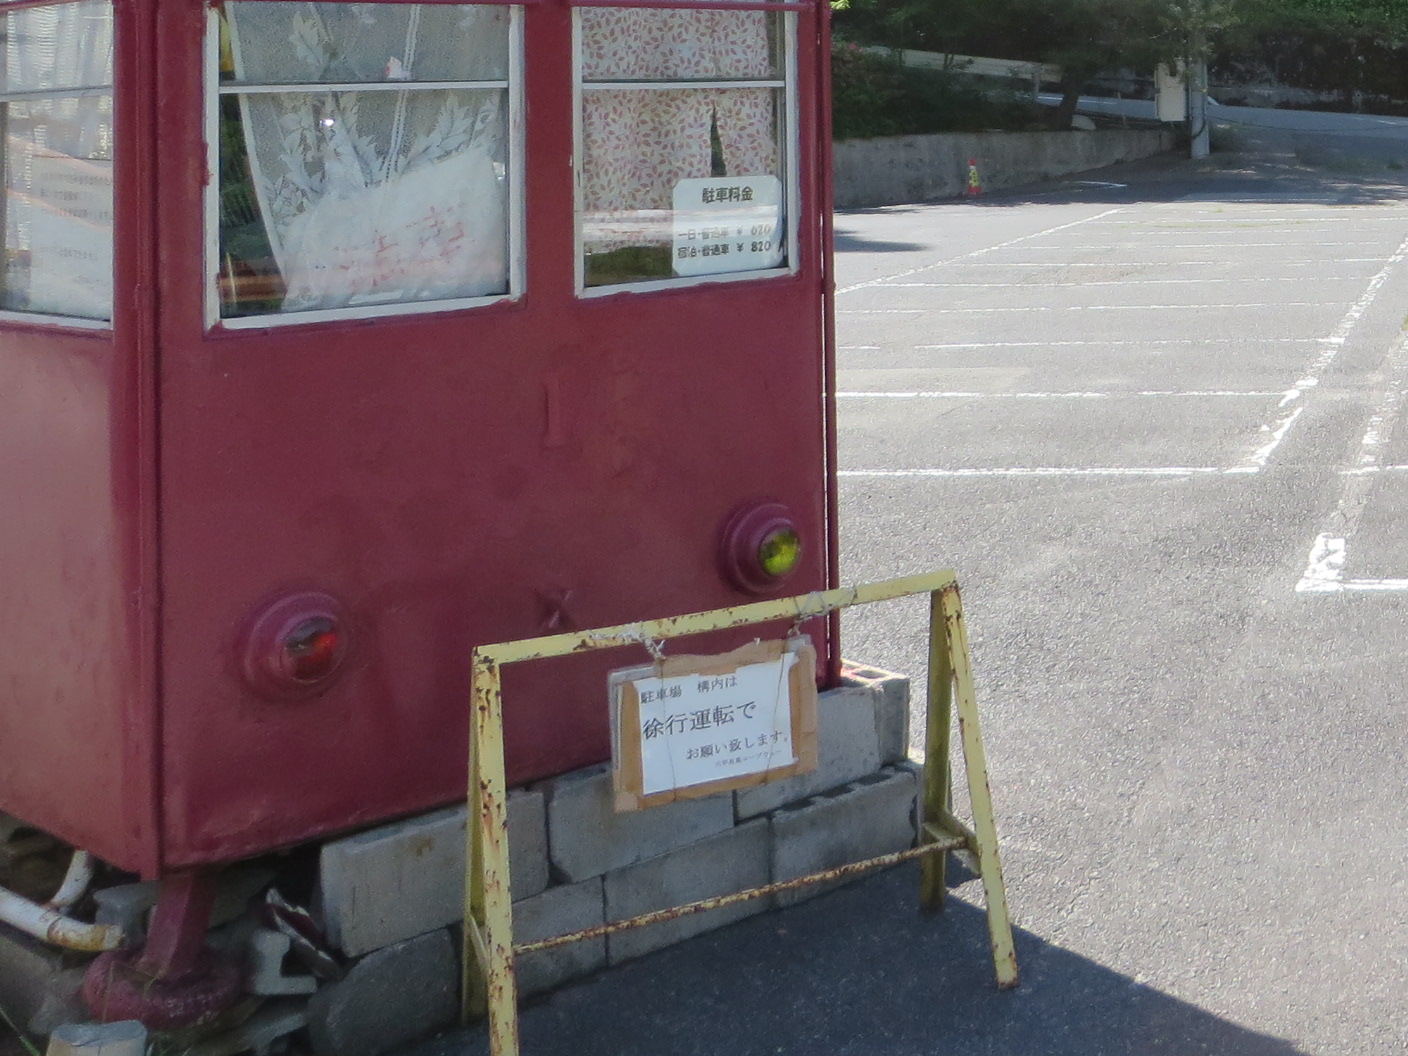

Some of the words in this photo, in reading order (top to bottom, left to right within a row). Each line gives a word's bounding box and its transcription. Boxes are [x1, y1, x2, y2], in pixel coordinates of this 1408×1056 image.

[702, 186, 753, 204] 駐車料金
[751, 241, 771, 252] 820
[641, 685, 682, 704] 駐車場
[697, 675, 738, 694] 構内は
[643, 701, 757, 740] 徐行運転で
